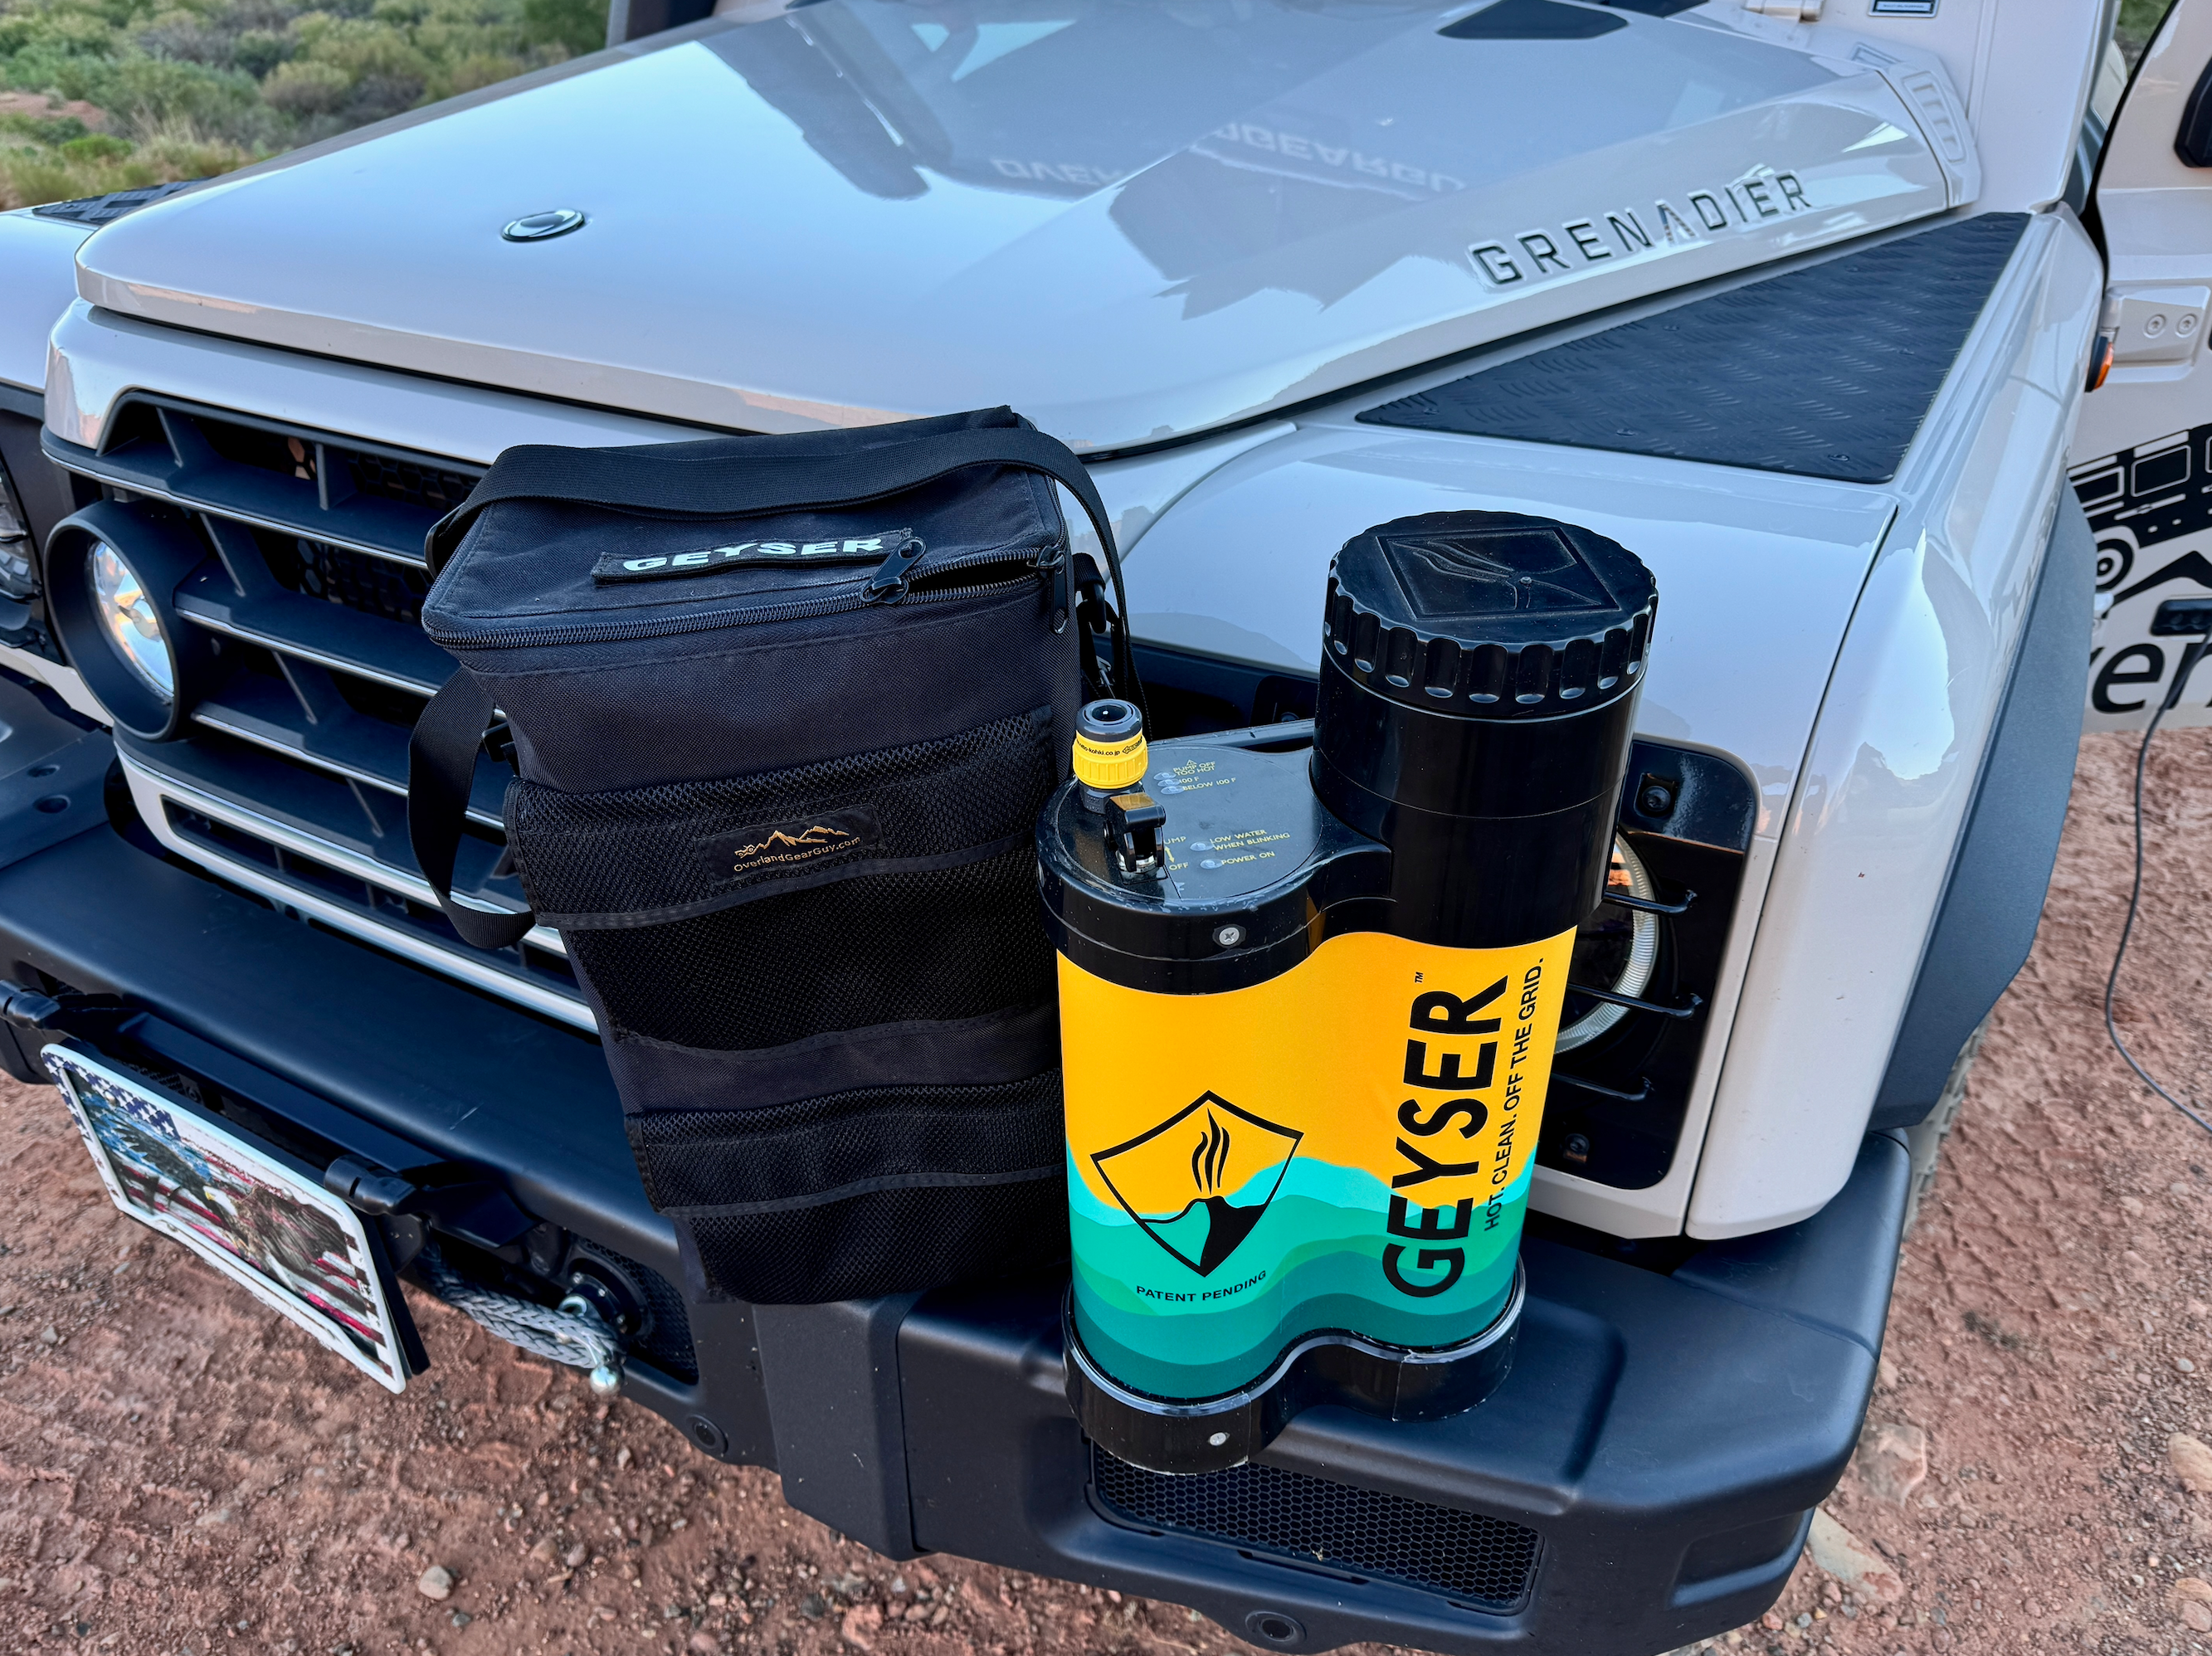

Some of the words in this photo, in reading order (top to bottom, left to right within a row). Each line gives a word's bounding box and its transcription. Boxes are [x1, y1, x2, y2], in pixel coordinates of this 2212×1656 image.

[1469, 170, 1812, 285] GRENADIER
[623, 538, 884, 571] GEYSER
[1173, 765, 1196, 773] PUMP
[1182, 782, 1213, 791] BELOW
[1163, 836, 1186, 845] UMP
[1210, 835, 1231, 844] LOW
[1235, 830, 1267, 840] WATER
[1214, 841, 1245, 851] WHEN
[1247, 832, 1290, 845] BLINKING
[734, 836, 861, 872] OverlandGearGuy.com
[1169, 862, 1189, 871] OFF
[1220, 855, 1257, 865] POWER
[1518, 957, 1543, 1020] GRID.
[1510, 1023, 1532, 1069] THE
[1503, 1073, 1523, 1111] OFF
[1382, 975, 1508, 1298] GEYSER
[1492, 1113, 1517, 1185] CLEAN.
[1484, 1186, 1505, 1231] HOT.
[1137, 1285, 1196, 1302] PATENT
[1202, 1270, 1266, 1301] PENDING
